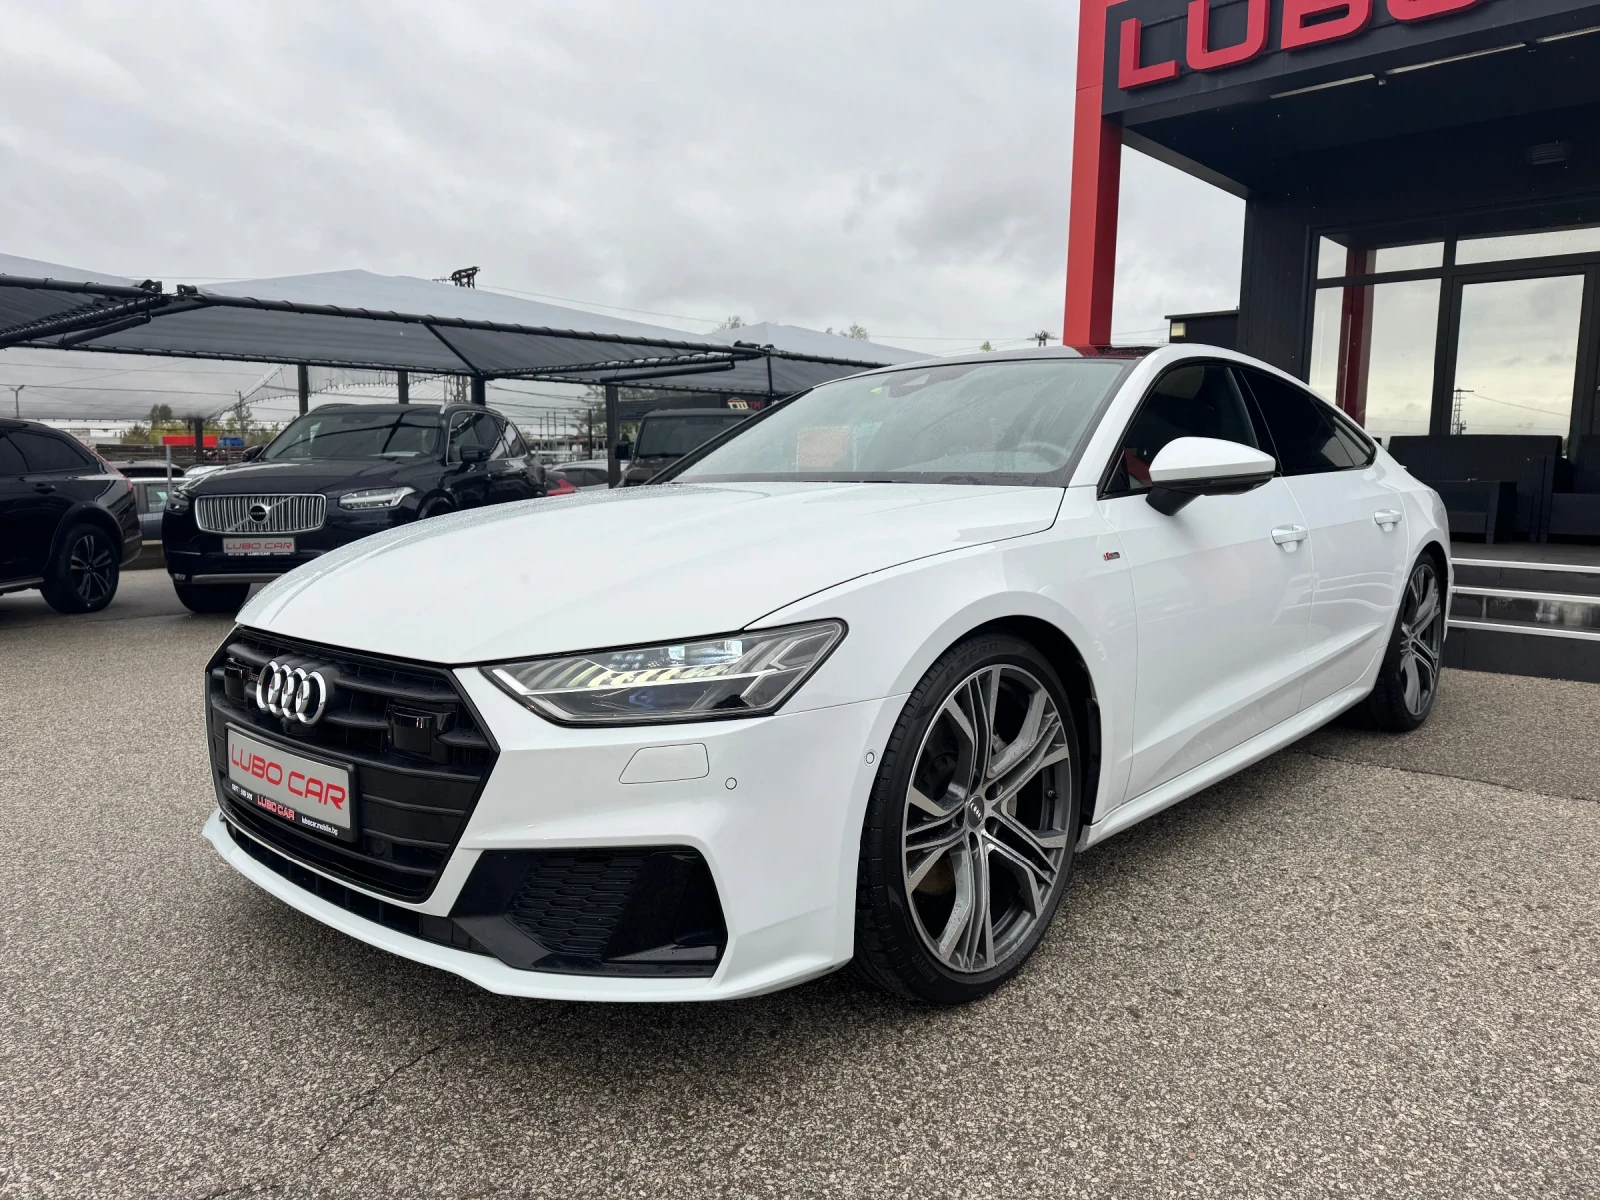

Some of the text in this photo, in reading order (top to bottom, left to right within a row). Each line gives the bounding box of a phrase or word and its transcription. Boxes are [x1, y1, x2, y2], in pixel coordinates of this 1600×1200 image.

[1118, 0, 1482, 91] LUB
[226, 542, 261, 550] LUBO
[957, 642, 999, 666] ZERO
[231, 743, 283, 786] LUBO
[287, 770, 346, 811] CAR
[257, 794, 295, 821] LUBO CAR
